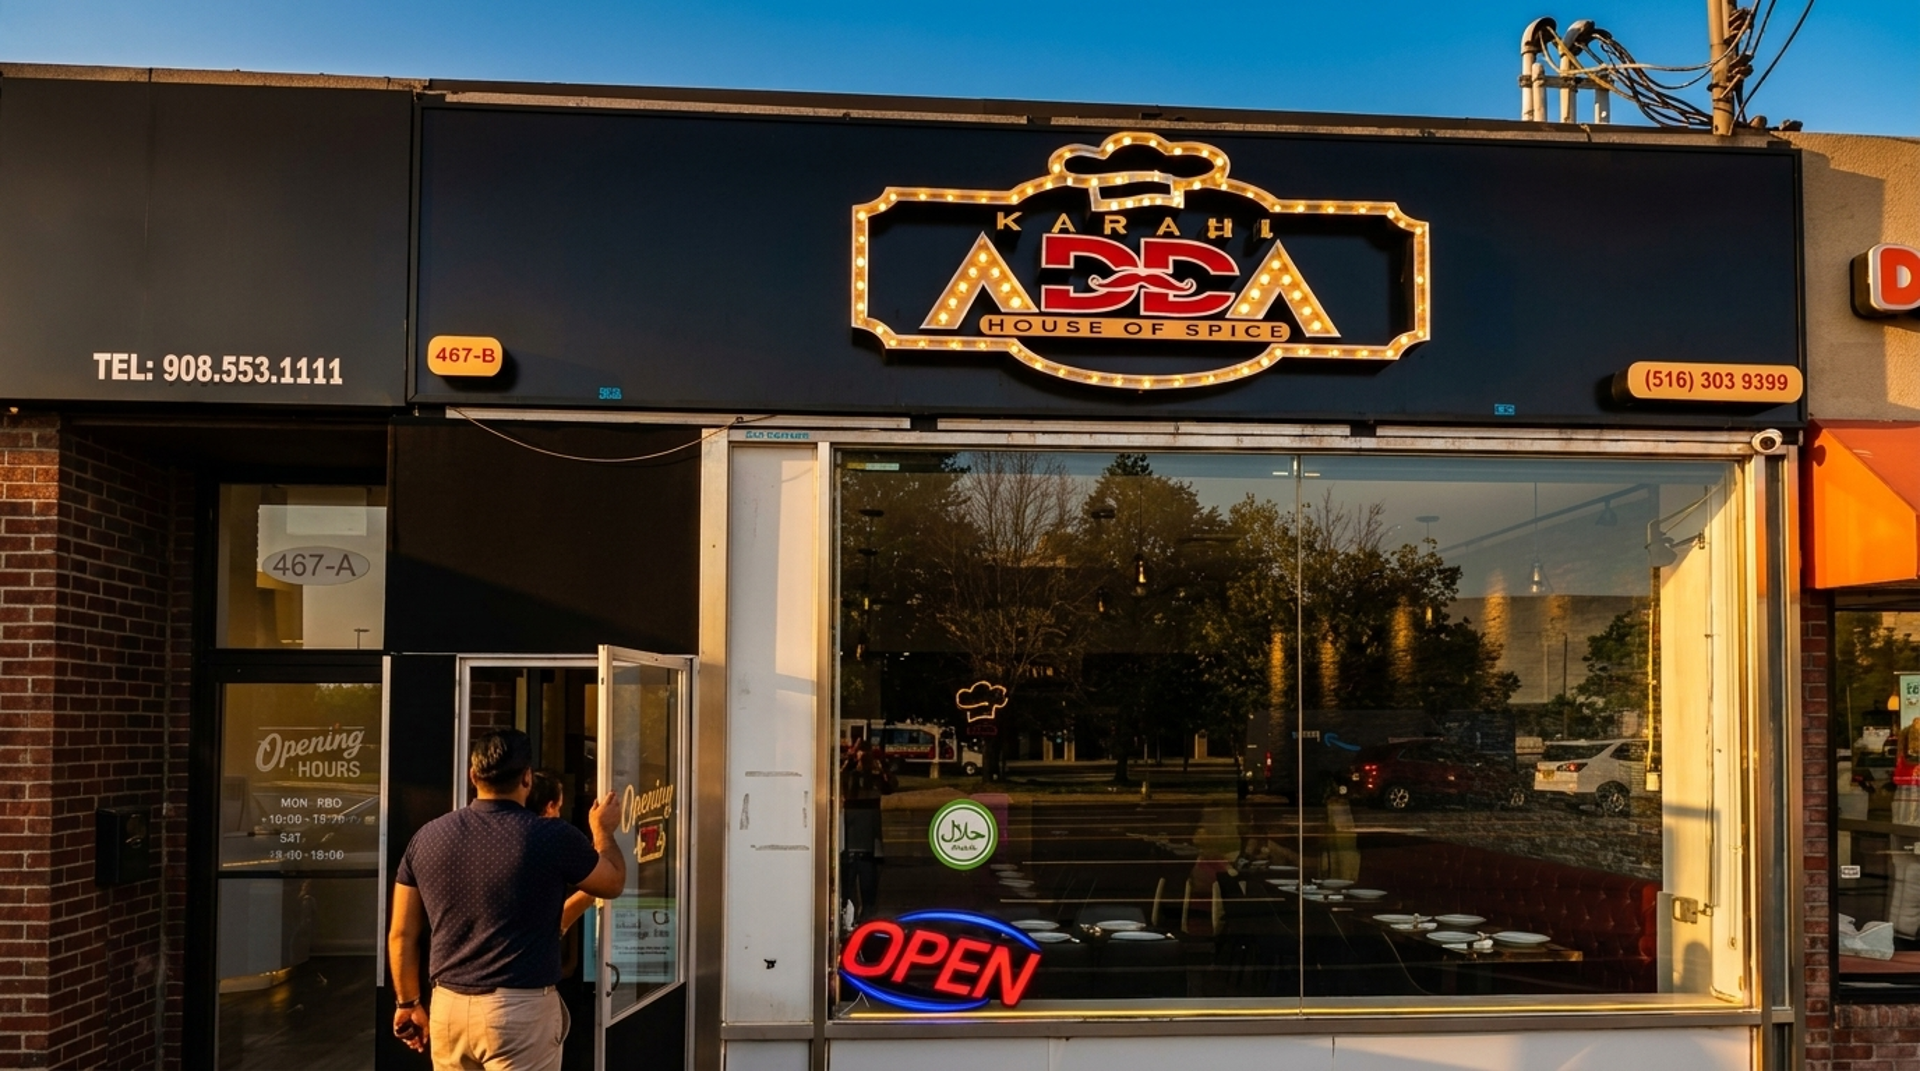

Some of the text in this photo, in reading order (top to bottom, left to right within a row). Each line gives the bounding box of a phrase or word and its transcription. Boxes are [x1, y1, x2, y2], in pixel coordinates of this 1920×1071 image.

[919, 231, 1341, 338] ADDA
[988, 319, 1284, 339] HOUSE OF SPICE
[435, 346, 496, 364] 467-B
[93, 353, 343, 385] TEL: 908.553.1111
[1645, 369, 1788, 393] (516) 303 9399
[272, 553, 357, 578] 467-A
[255, 726, 365, 773] Opening
[298, 761, 361, 778] HOURS
[281, 797, 308, 808] MON
[621, 779, 674, 834] Opening
[841, 919, 1042, 1007] OPEN
